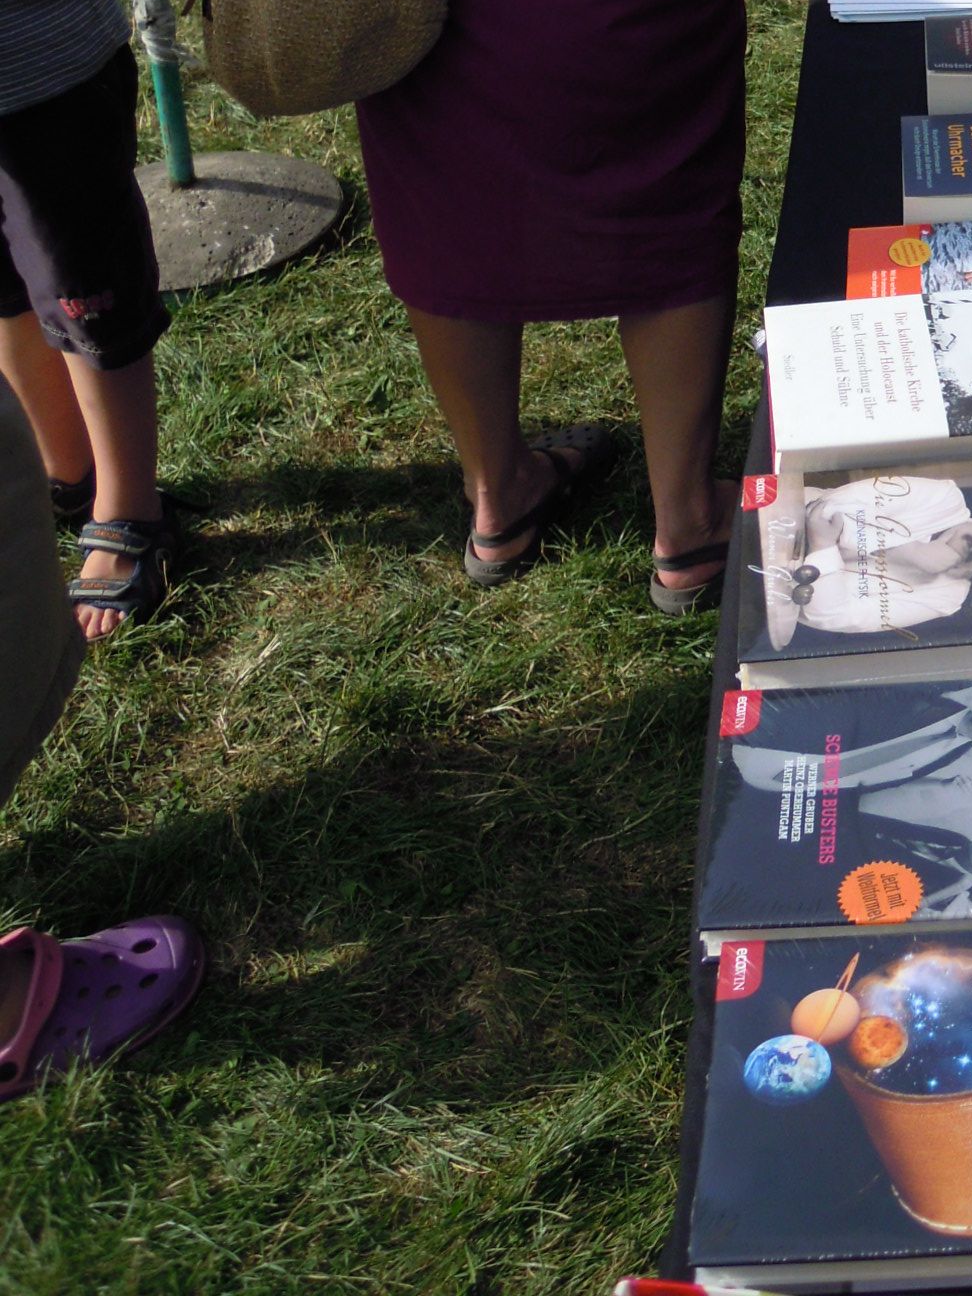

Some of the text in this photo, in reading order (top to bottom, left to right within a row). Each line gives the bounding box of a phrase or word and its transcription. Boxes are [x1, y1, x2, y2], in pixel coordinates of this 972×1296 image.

[947, 124, 968, 177] Uhrmacher
[783, 355, 795, 381] Siedler
[830, 325, 852, 407] Schuld und Sühne
[850, 313, 878, 420] Eine Untersuchung über
[874, 322, 897, 404] und der Holocaust
[894, 312, 926, 412] Die katholische Kirche
[872, 476, 911, 508] Die
[747, 517, 796, 607] Werner Gruber
[855, 509, 869, 598] KULINARISCHE PHYSIK
[778, 760, 794, 840] MARTIN PUNTIGAM
[791, 756, 807, 842] HEINZ OBERHUMMER
[804, 763, 818, 834] WERNER GRUBER
[819, 734, 841, 864] SCIENCE BUSTERS
[880, 873, 906, 909] Jetzt mit
